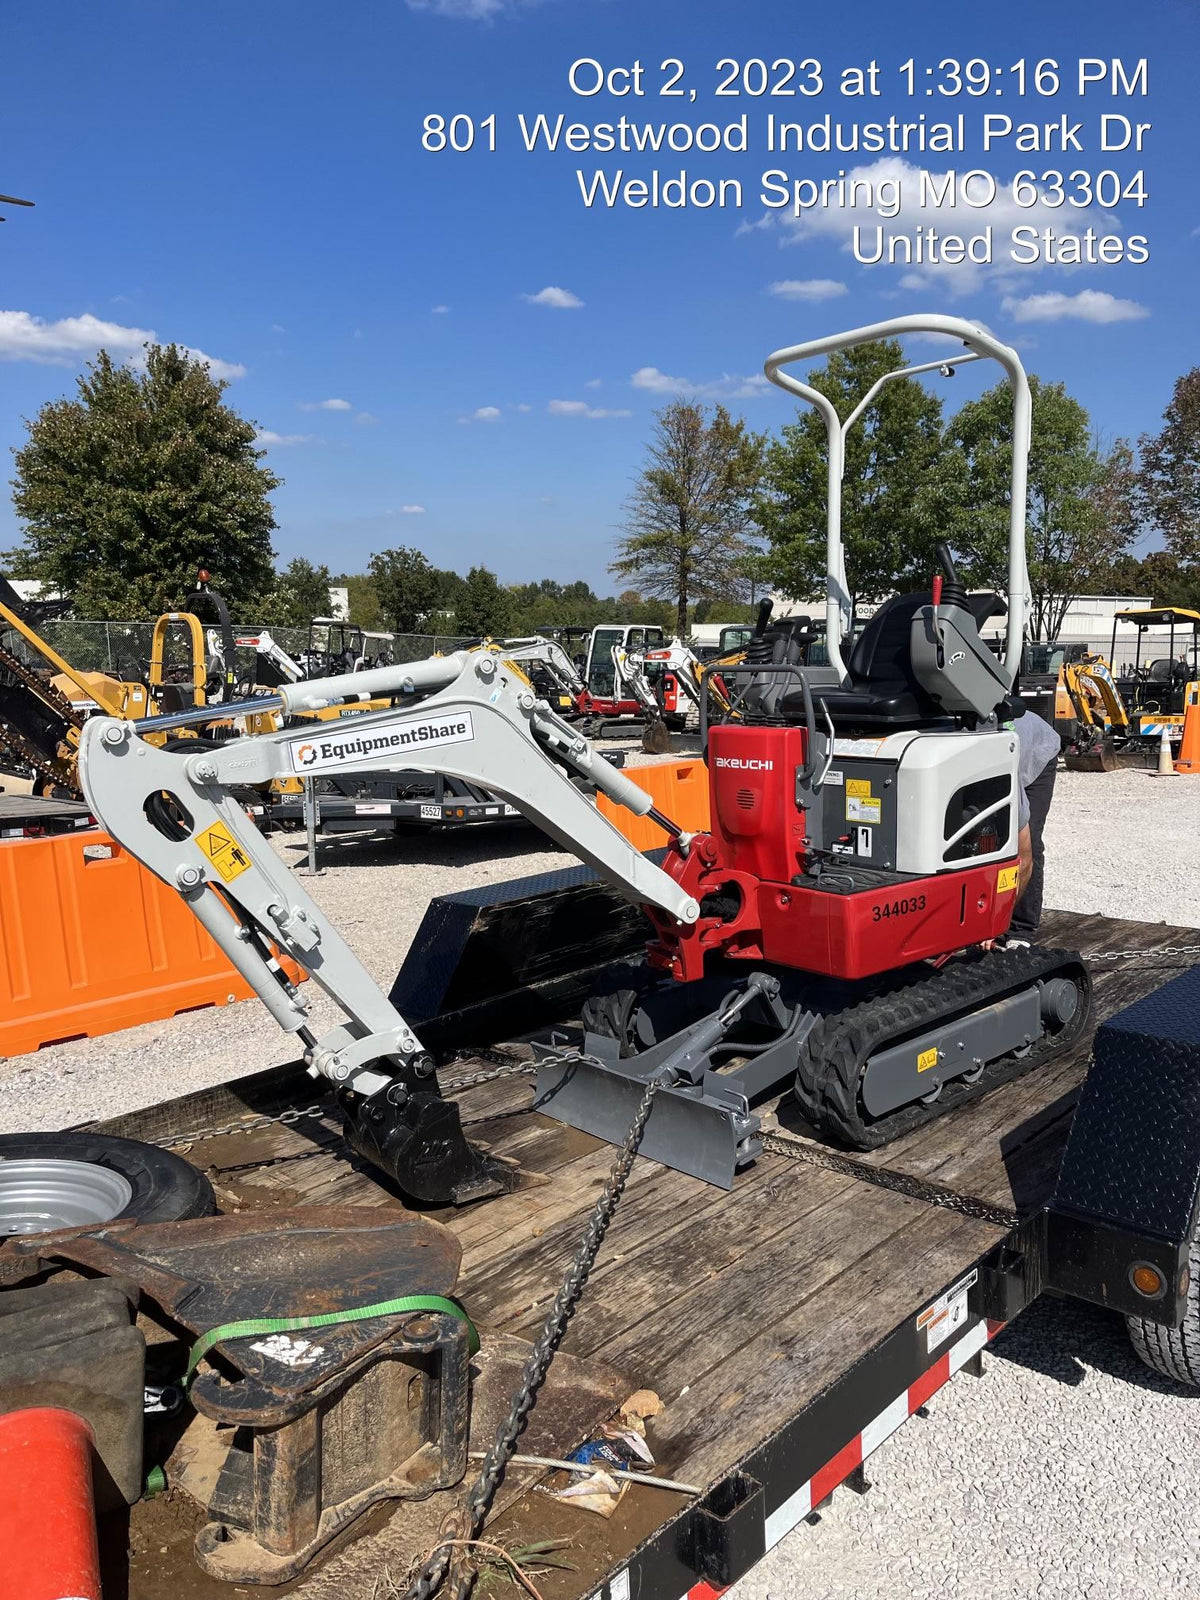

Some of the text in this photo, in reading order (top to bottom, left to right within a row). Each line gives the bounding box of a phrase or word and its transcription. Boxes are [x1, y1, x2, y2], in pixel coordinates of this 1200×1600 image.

[319, 722, 467, 760] EquipmentShare
[714, 756, 774, 771] AKEUCHI
[421, 806, 441, 818] 45527
[871, 894, 927, 922] 344033
